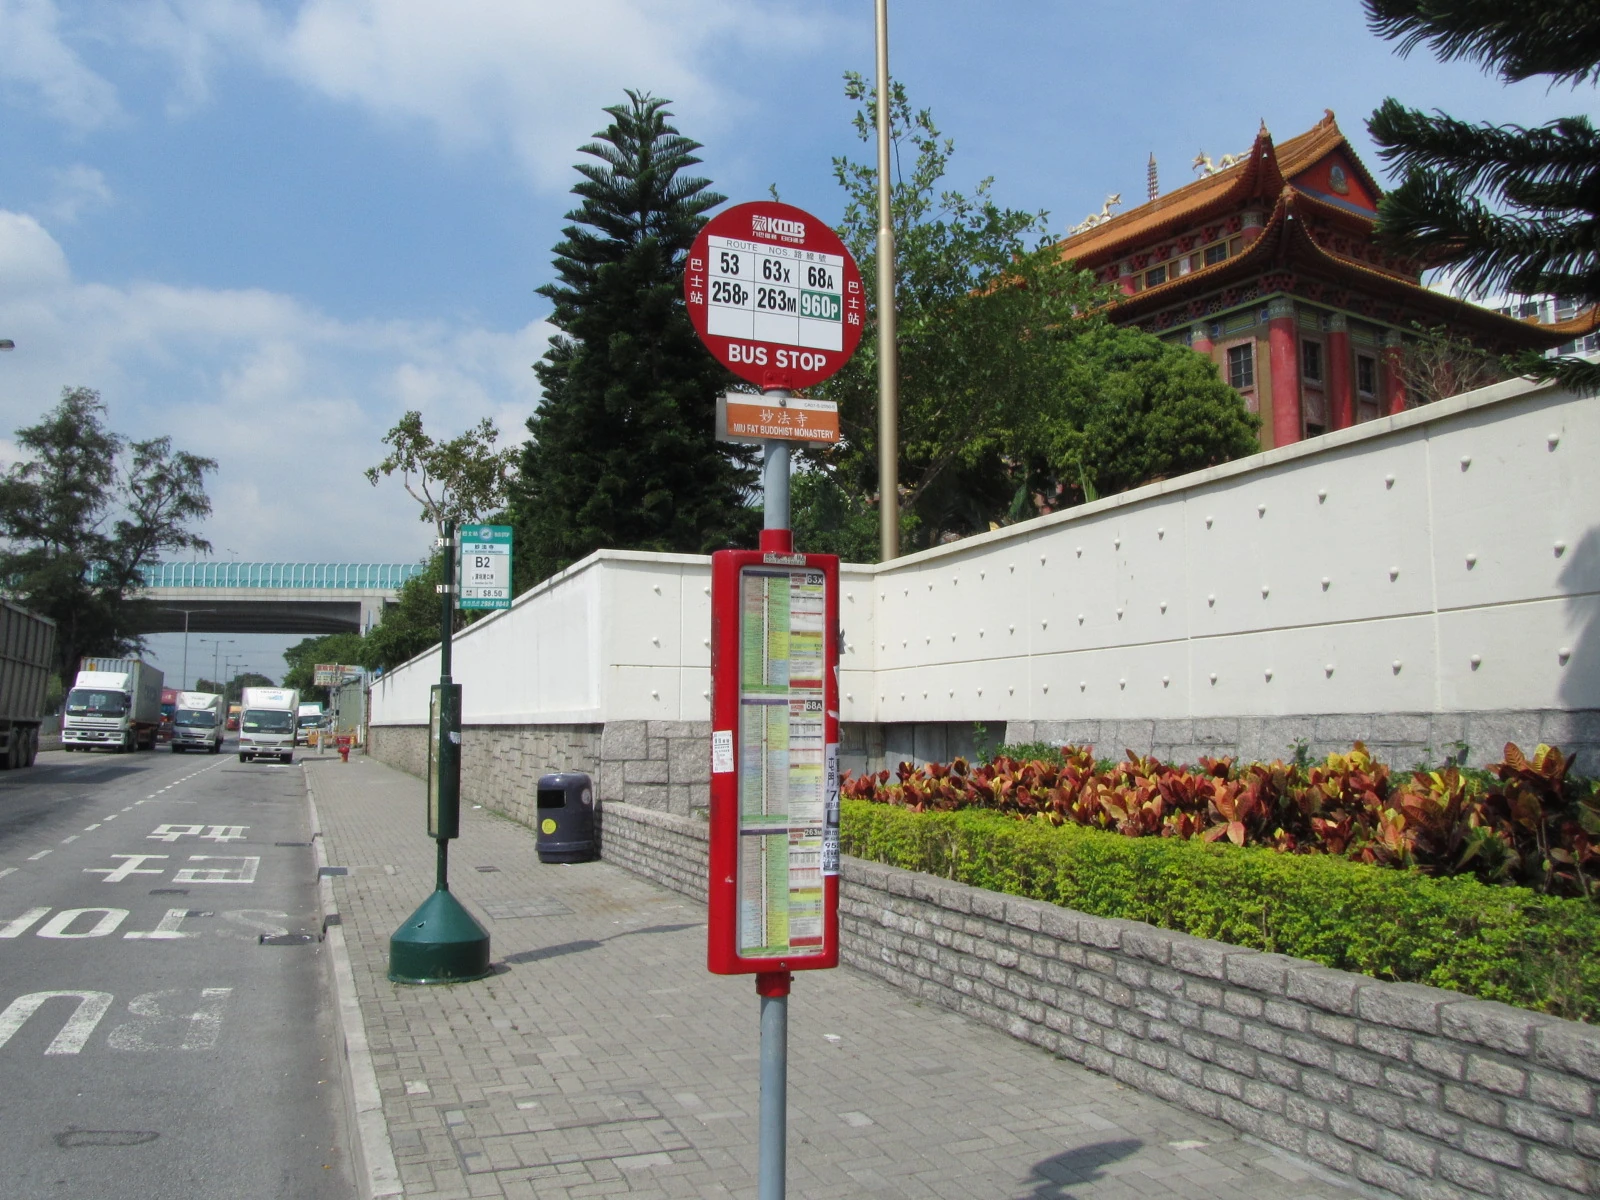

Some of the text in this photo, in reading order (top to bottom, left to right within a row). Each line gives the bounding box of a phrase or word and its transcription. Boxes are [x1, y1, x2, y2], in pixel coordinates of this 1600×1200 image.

[767, 217, 806, 238] KMB
[726, 239, 758, 252] ROUTE
[768, 246, 791, 257] NOS.
[720, 251, 740, 275] 53
[689, 258, 704, 305] 巴士站
[807, 266, 834, 290] 68A
[712, 281, 748, 306] 258P
[757, 287, 797, 313] 263M
[847, 280, 860, 326] 巴士站
[801, 293, 839, 319] 960P
[728, 343, 827, 372] BUS STOP
[759, 409, 808, 427] 妙法寺
[733, 423, 834, 439] MIU FAT BUDDHIST MONASTERY
[475, 556, 490, 568] B2
[806, 701, 822, 710] 68A
[146, 823, 251, 844] 站
[82, 854, 261, 885] 巴士
